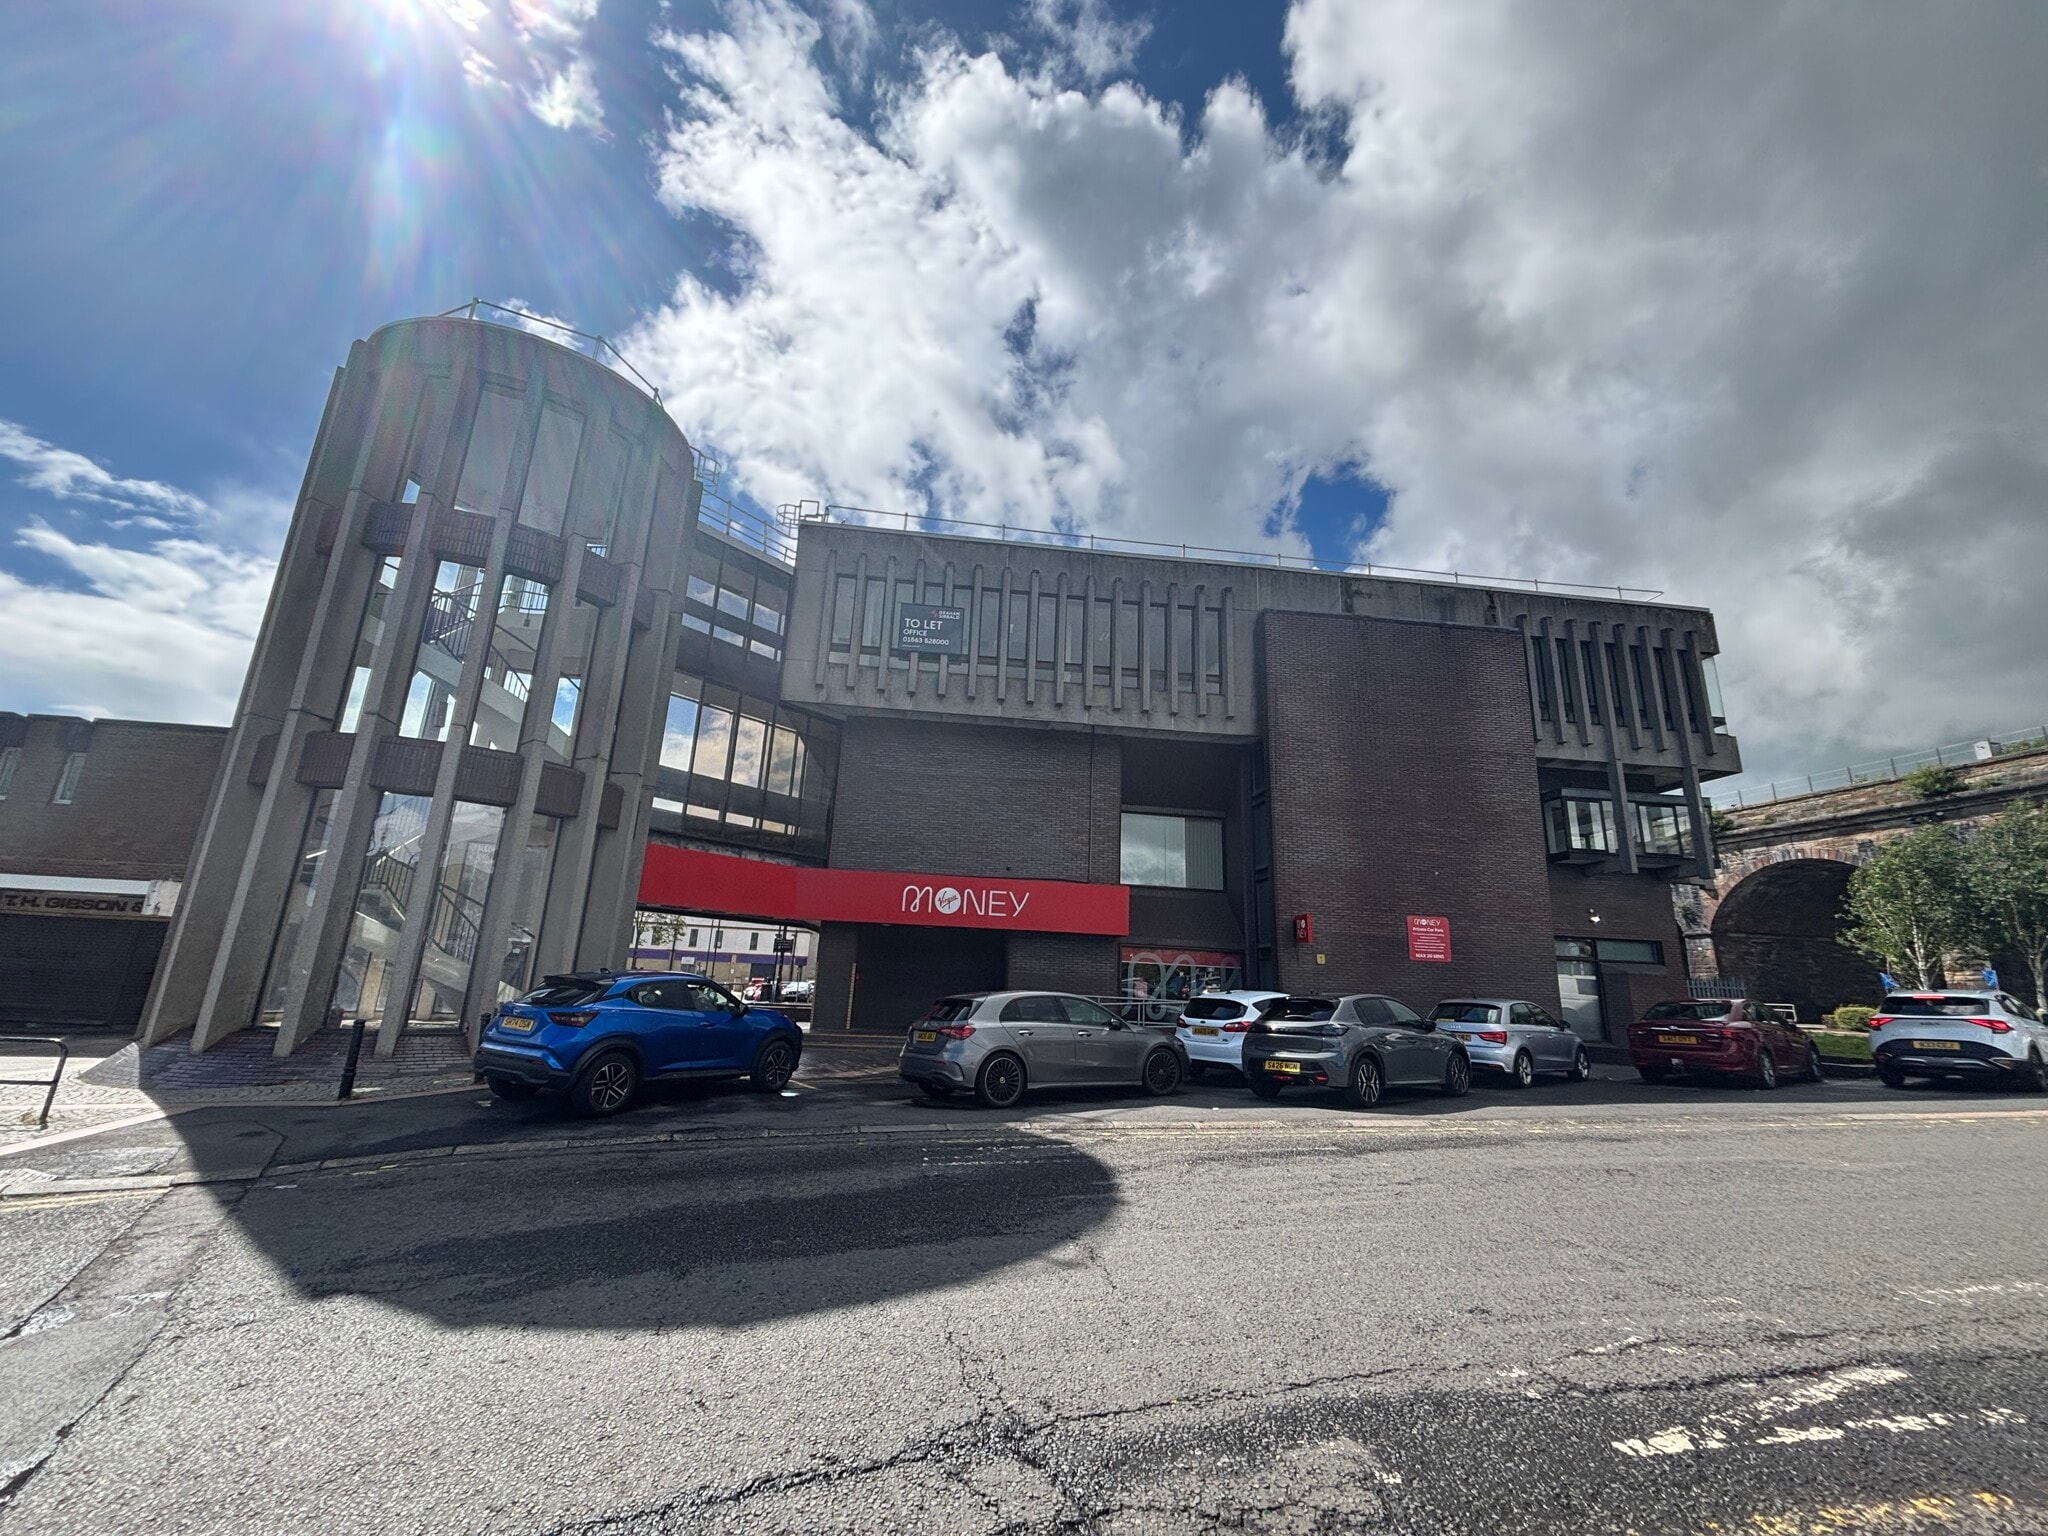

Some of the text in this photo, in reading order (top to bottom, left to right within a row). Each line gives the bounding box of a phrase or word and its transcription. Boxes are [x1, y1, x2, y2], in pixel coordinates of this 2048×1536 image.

[905, 618, 943, 630] TO LET
[903, 629, 927, 637] OFFICE
[45, 897, 128, 913] GIBSON
[902, 885, 1030, 917] MONEY
[938, 891, 958, 910] Virgin
[1414, 918, 1441, 926] MONEY
